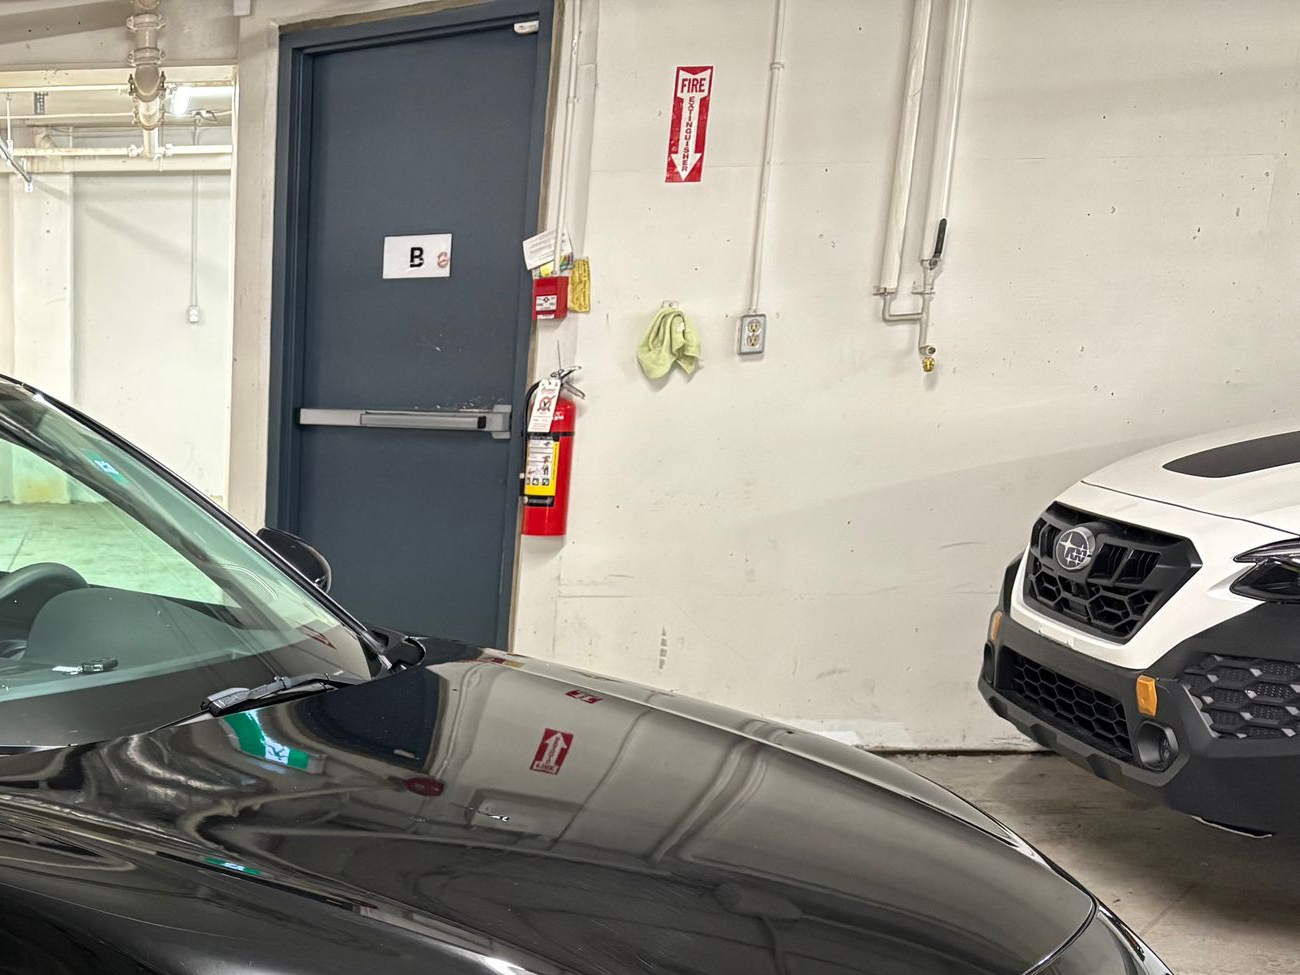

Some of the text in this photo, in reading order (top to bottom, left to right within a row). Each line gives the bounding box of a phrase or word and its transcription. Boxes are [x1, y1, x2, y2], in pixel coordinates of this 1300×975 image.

[681, 78, 706, 93] FIRE
[682, 96, 694, 171] EXTINGUISHER
[410, 247, 424, 268] B
